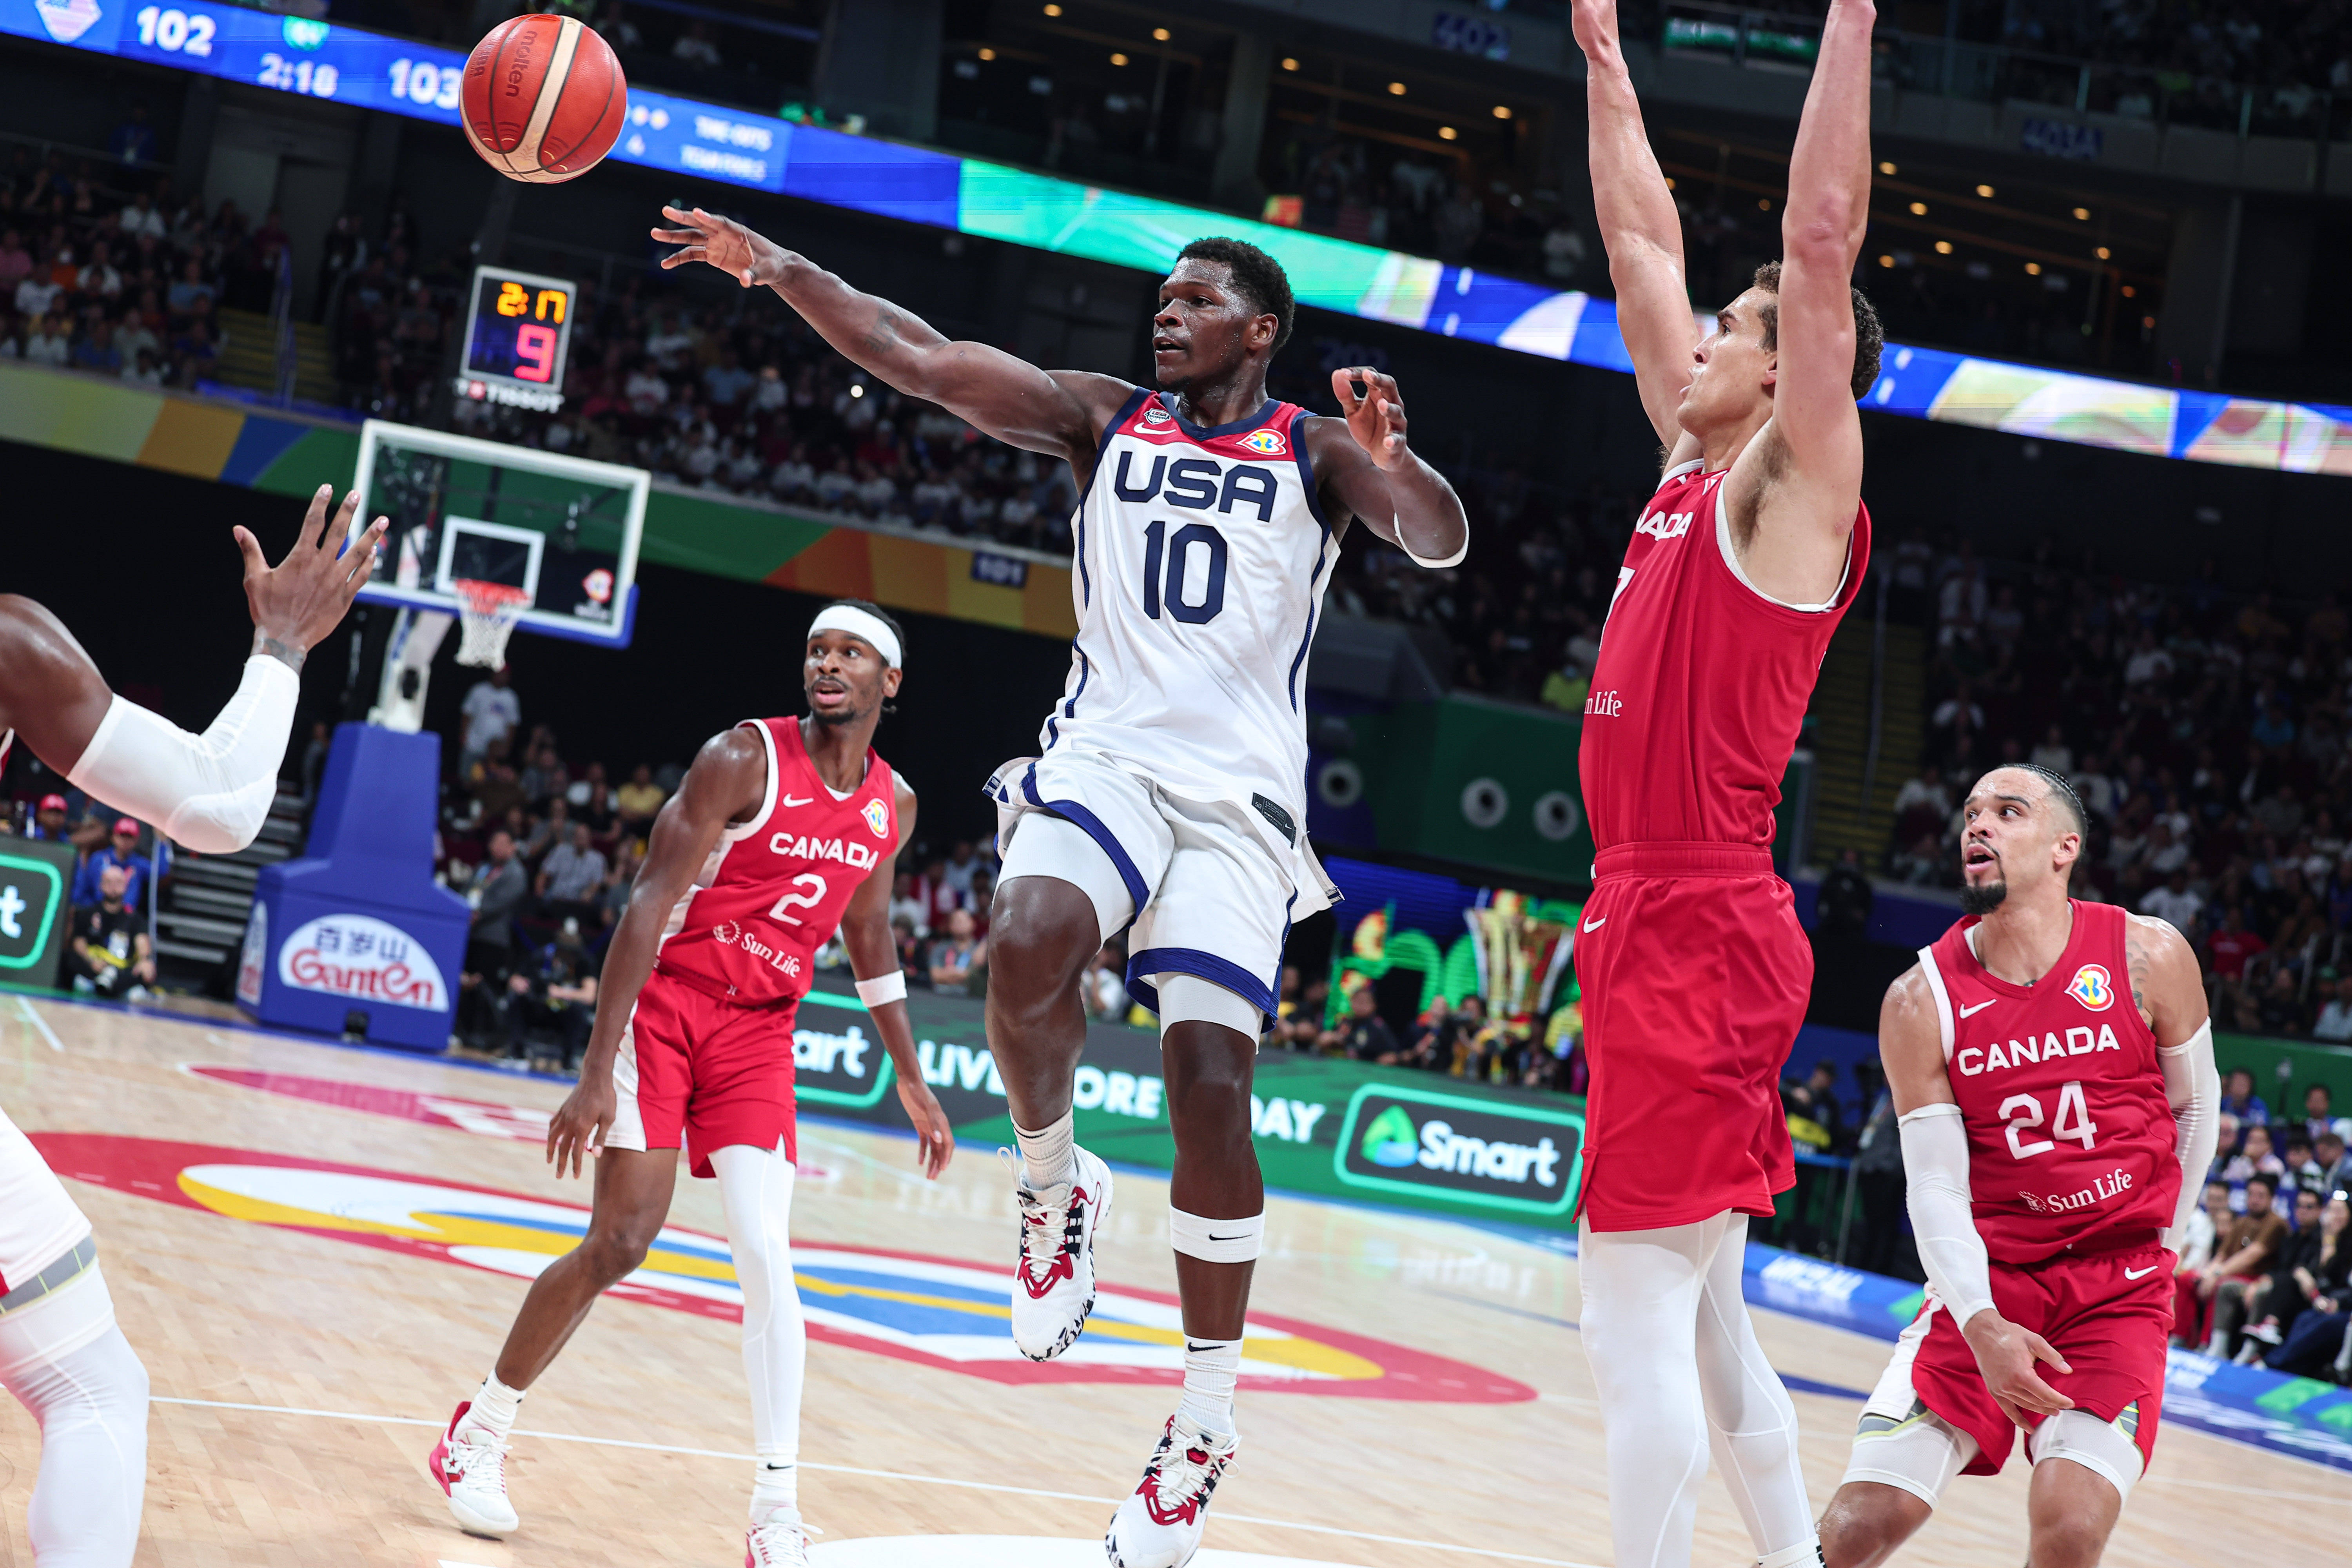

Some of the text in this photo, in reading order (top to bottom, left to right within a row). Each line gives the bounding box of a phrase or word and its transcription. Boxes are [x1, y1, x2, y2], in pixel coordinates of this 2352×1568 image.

[136, 5, 217, 58] 102
[257, 53, 339, 98] 2:18
[389, 58, 460, 110] 103
[505, 30, 538, 97] molten
[514, 323, 556, 383] 9
[1114, 451, 1278, 523] USA
[1635, 506, 1693, 541] NADA
[1144, 521, 1228, 624] 10
[1593, 690, 1622, 717] Life
[769, 832, 879, 872] CANADA
[768, 873, 828, 926] 2
[741, 932, 800, 978] Sun Life
[793, 1025, 871, 1079] art
[1958, 1024, 2121, 1076] CANADA
[1073, 1065, 1163, 1120] ORE
[1251, 1093, 1327, 1144] DAY
[1998, 1080, 2098, 1160] 24
[1418, 1120, 1561, 1188] Smart
[2047, 1168, 2132, 1212] Sun Life
